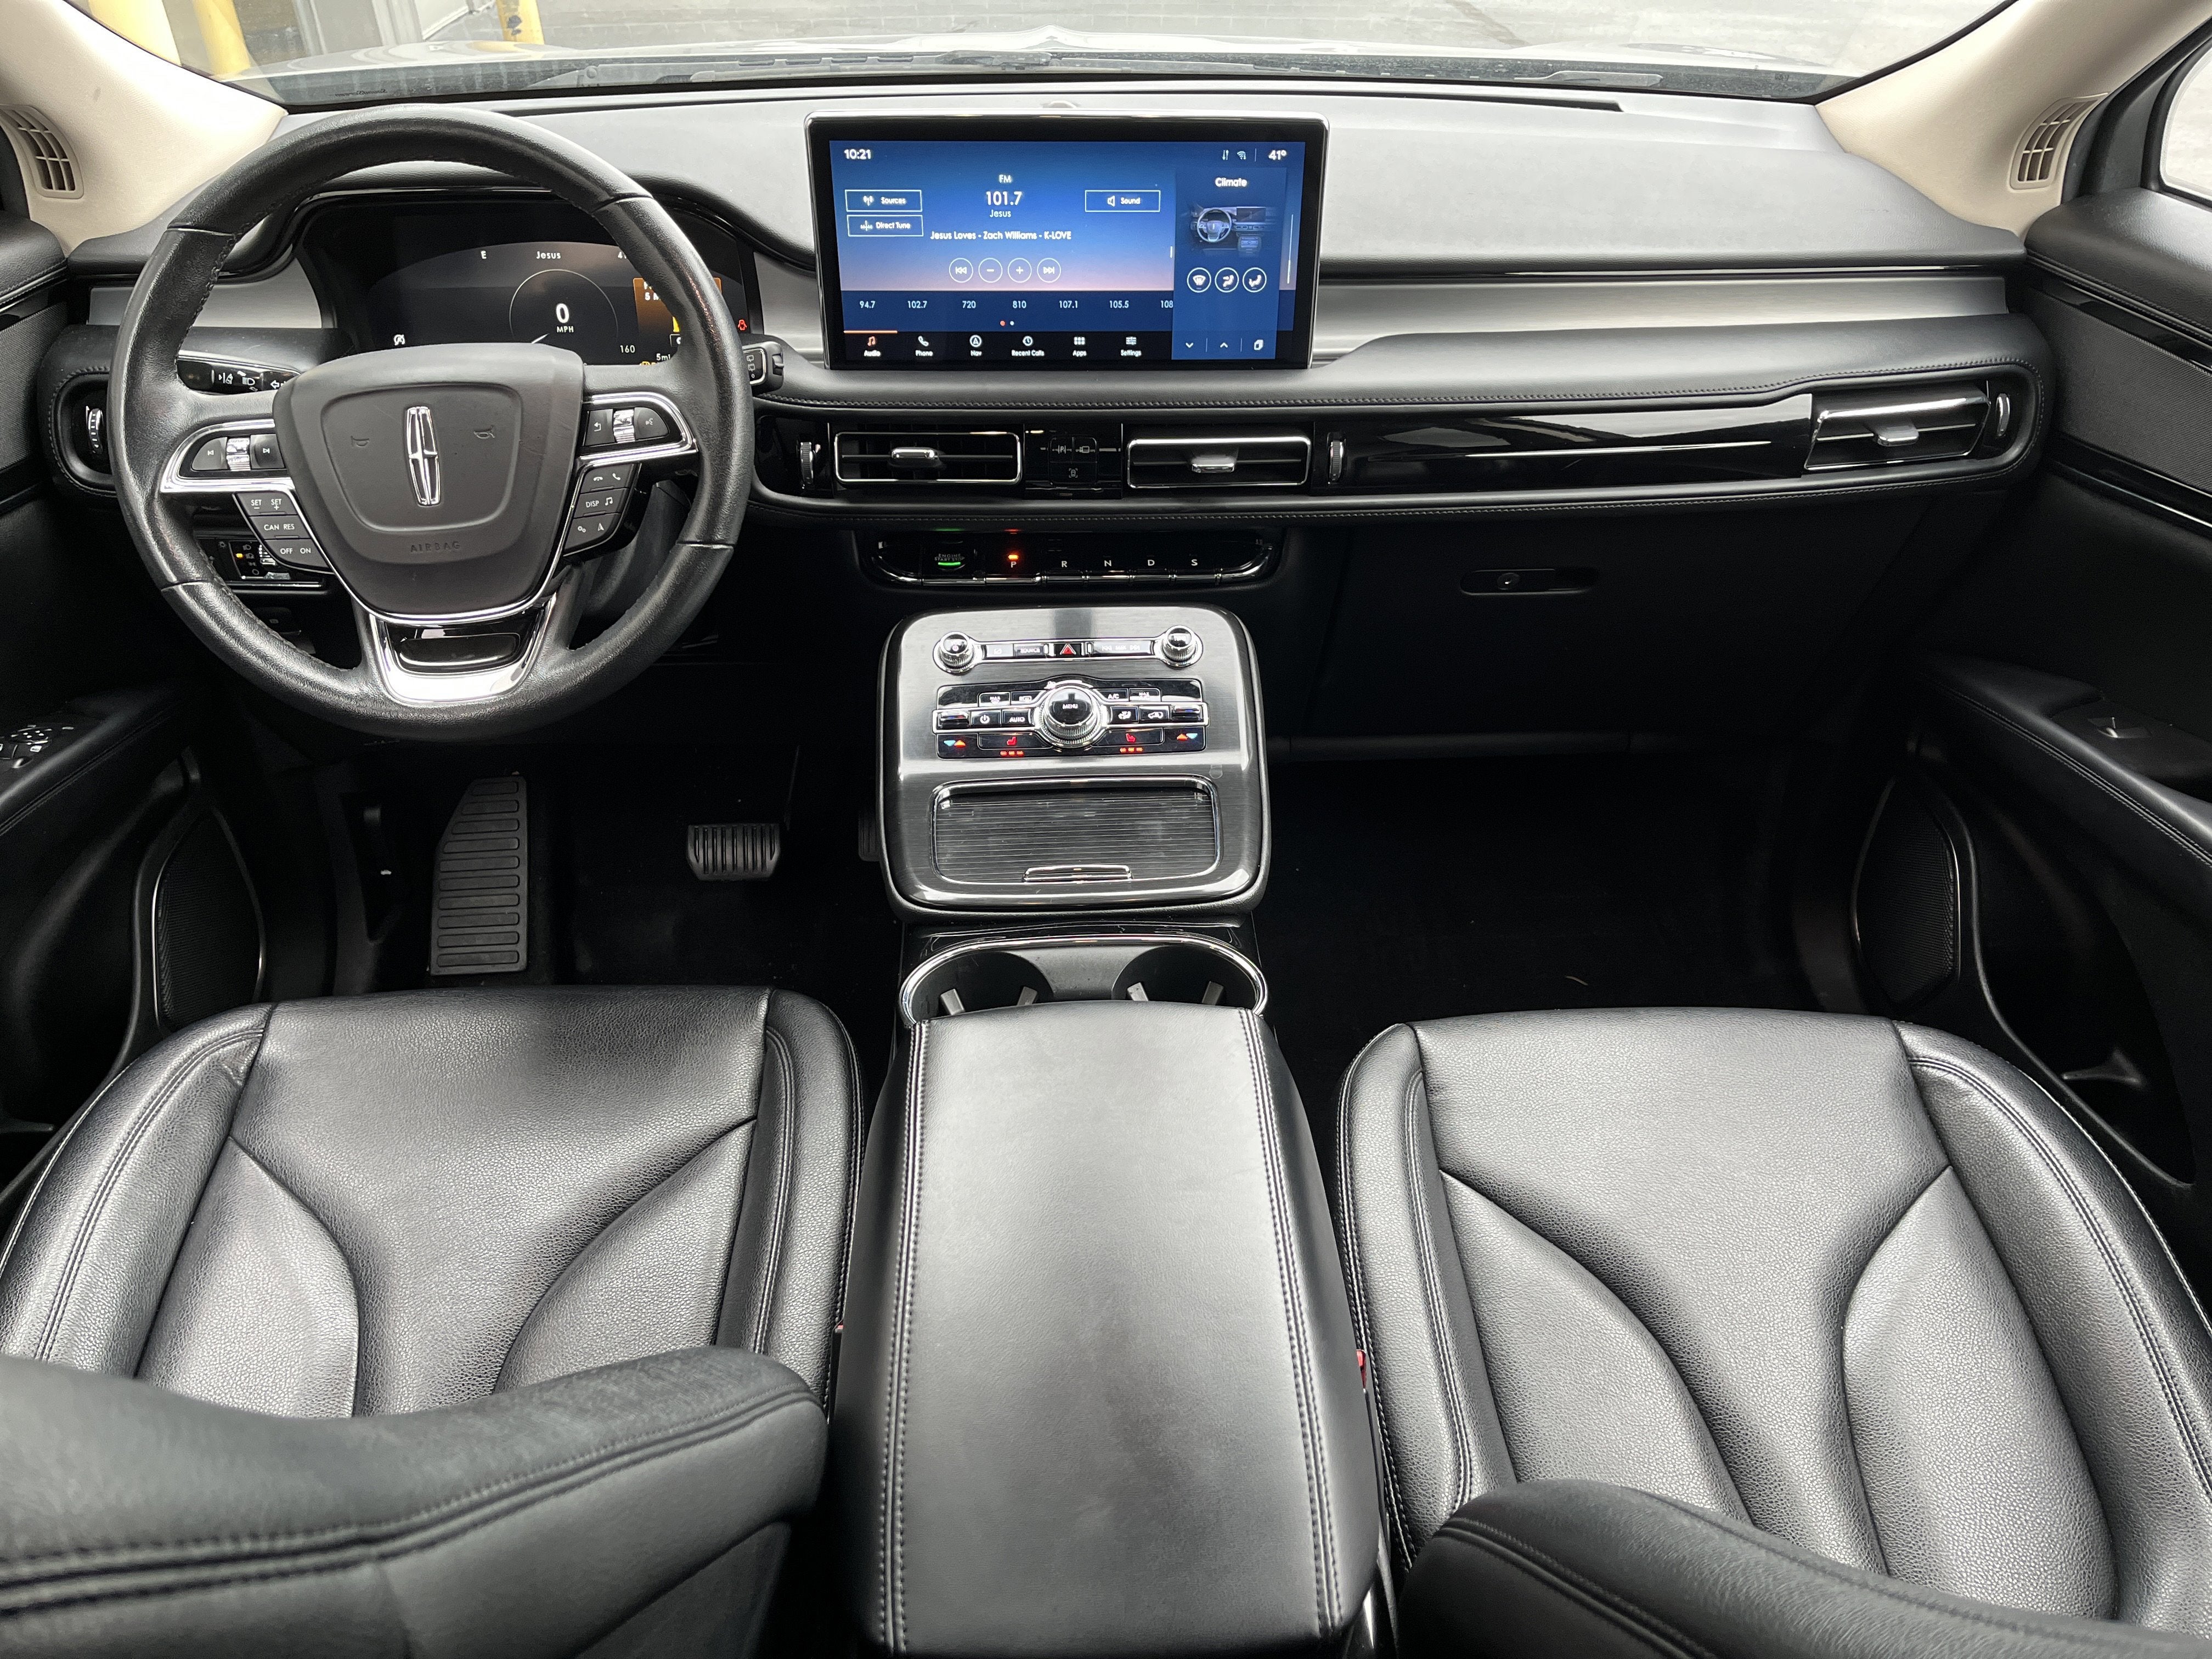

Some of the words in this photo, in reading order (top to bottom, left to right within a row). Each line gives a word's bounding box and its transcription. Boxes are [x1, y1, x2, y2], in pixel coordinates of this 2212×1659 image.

[844, 149, 871, 160] 10:21
[998, 174, 1012, 183] FM
[1215, 177, 1247, 187] Climate
[986, 191, 1022, 205] 101.7
[1120, 197, 1140, 205] Sound
[990, 210, 1011, 218] Jesus
[930, 232, 952, 240] Jesus
[953, 231, 976, 240] Loves
[983, 231, 1003, 240] Zach
[1005, 231, 1037, 240] Williams
[1044, 231, 1071, 240] K-LOVE
[481, 251, 487, 259] E
[1012, 300, 1026, 308] 810
[1059, 300, 1078, 308] 107.1
[1109, 300, 1129, 308] 105.5
[556, 303, 569, 324] 0
[410, 541, 460, 552] AIRBAG
